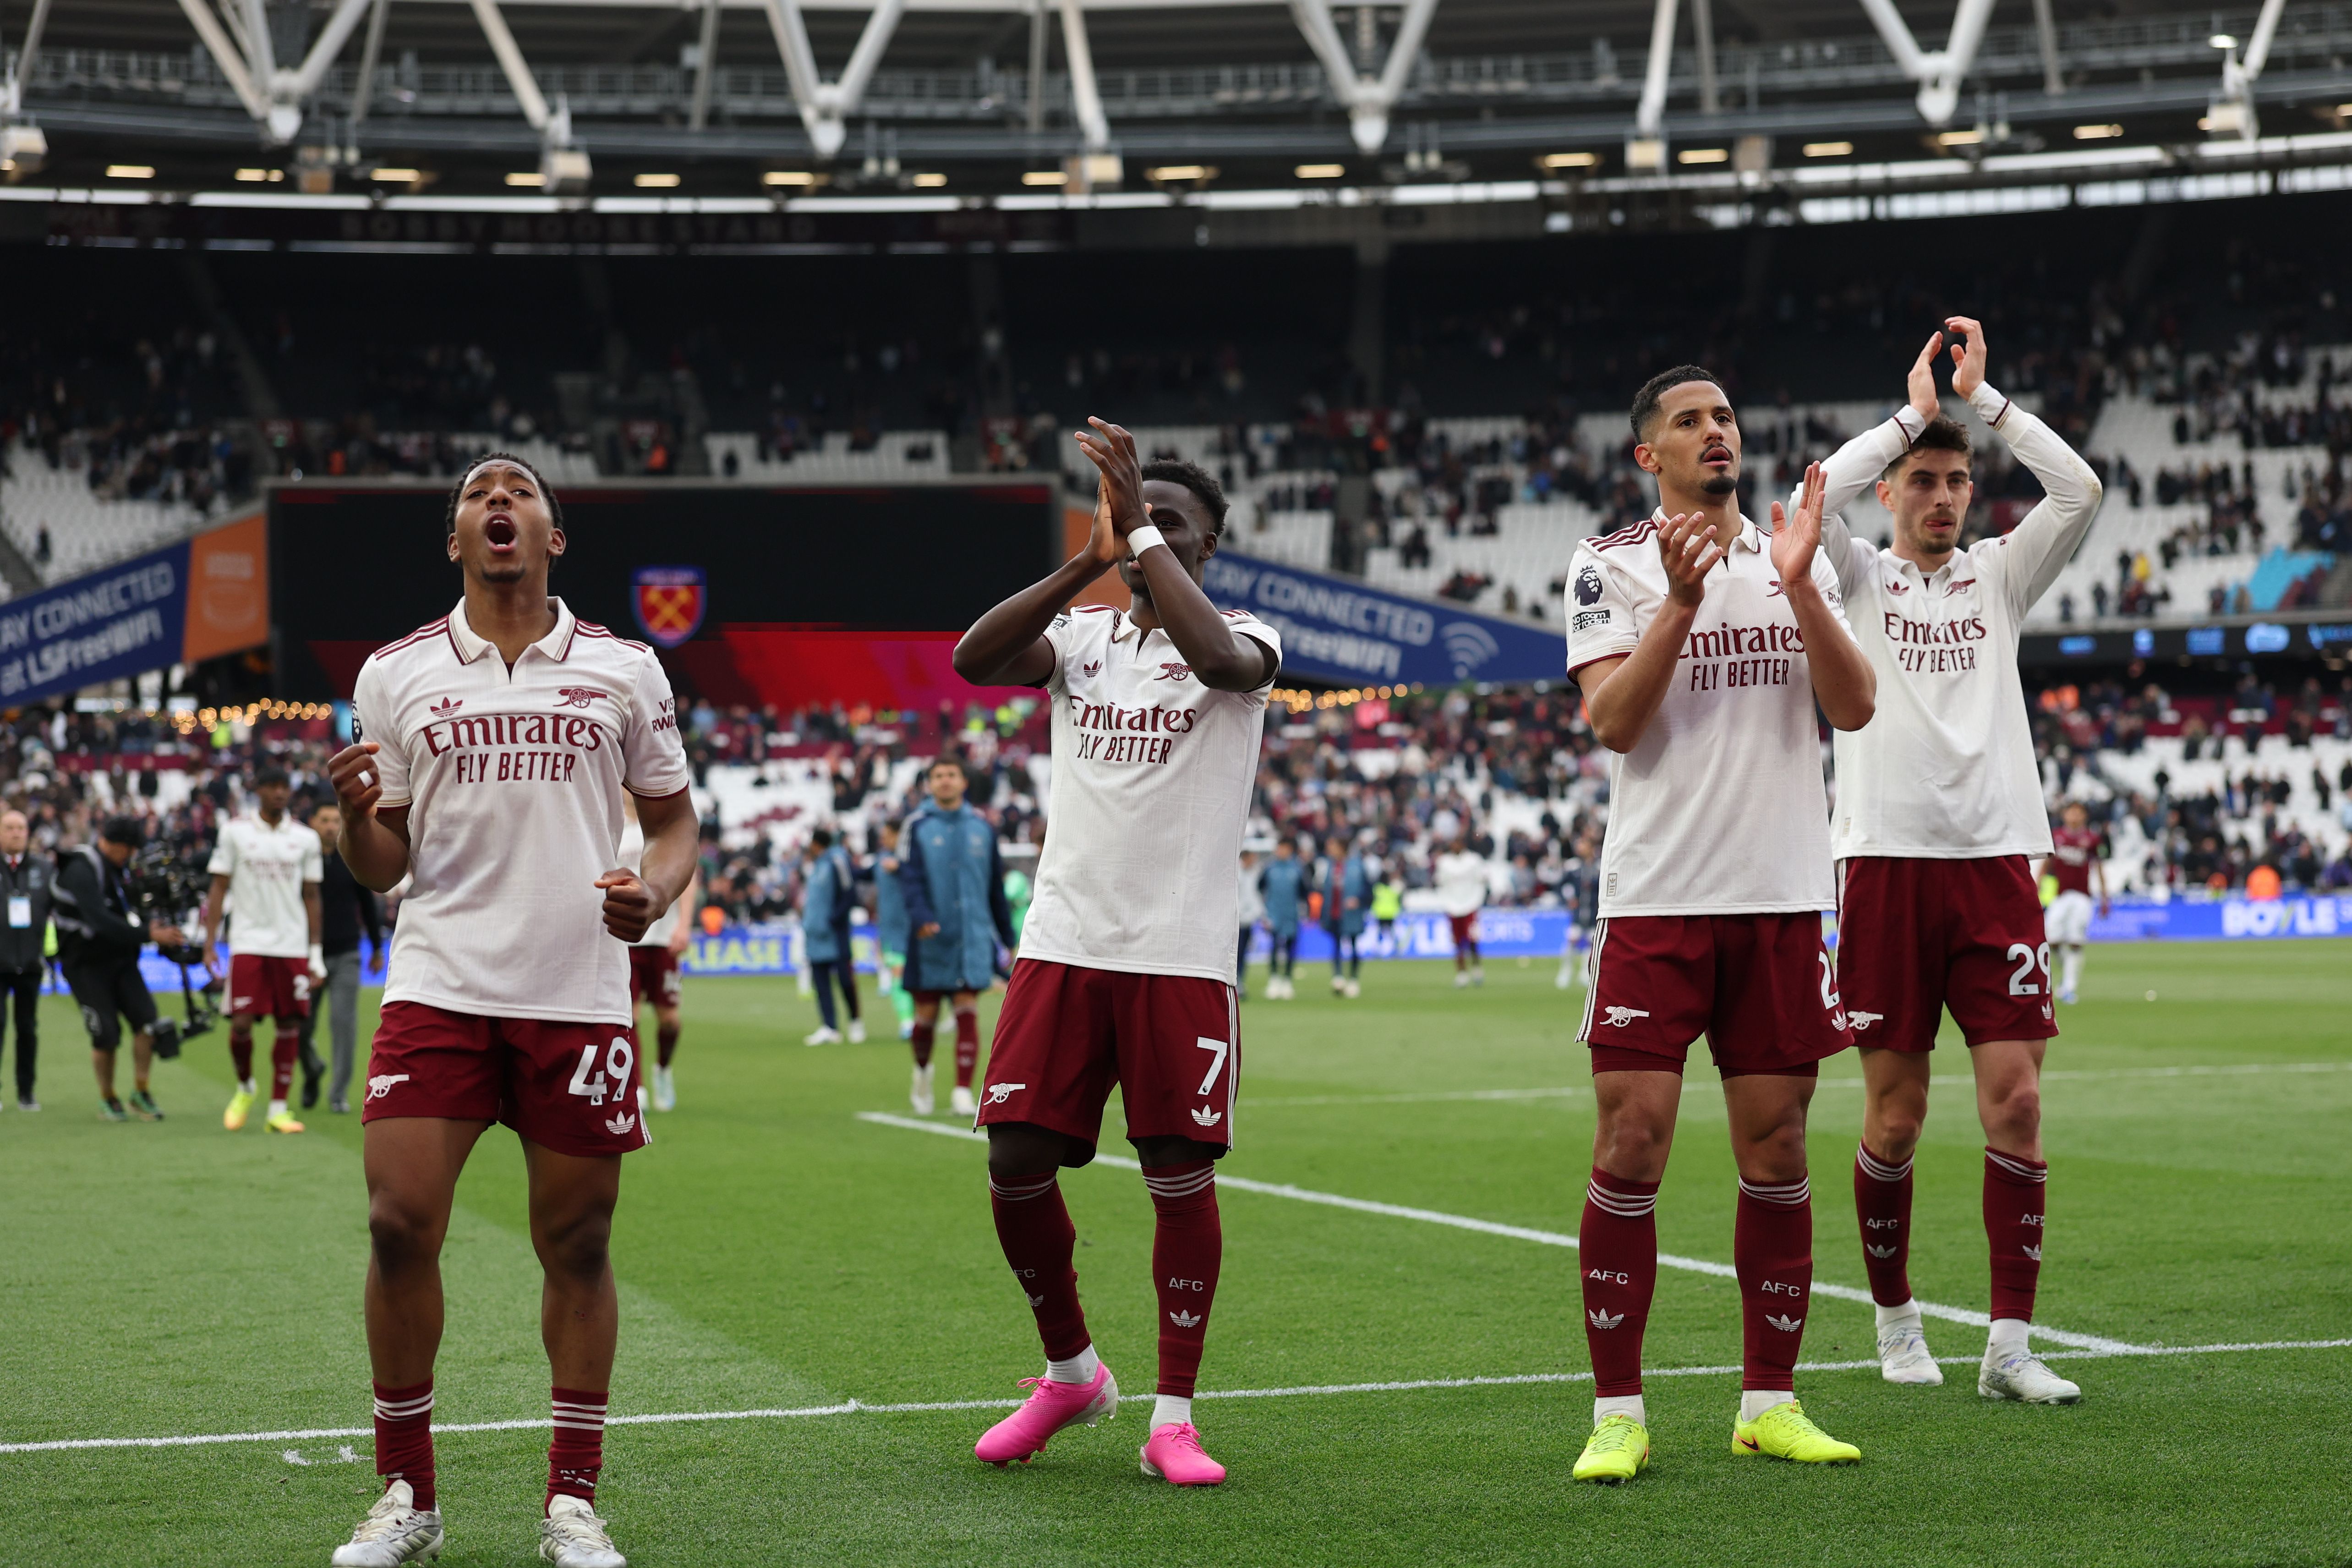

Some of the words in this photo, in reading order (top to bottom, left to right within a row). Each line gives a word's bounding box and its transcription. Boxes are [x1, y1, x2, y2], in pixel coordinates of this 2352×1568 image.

[32, 561, 176, 641] CONNECTED
[1256, 570, 1435, 647] CONNECTED
[1572, 616, 1581, 625] No
[1581, 612, 1606, 622] room
[1572, 623, 1581, 634] for
[1581, 617, 1611, 628] racism
[1678, 621, 1805, 659] mirates
[1690, 663, 1719, 692] FLY
[1728, 658, 1789, 688] BETTER
[1899, 648, 1926, 672] FLY
[421, 713, 603, 758] Emirates
[1077, 733, 1105, 759] FLY
[1103, 736, 1172, 765] BETTER
[457, 753, 490, 784] FLY
[498, 752, 576, 783] BETTER
[2007, 941, 2051, 996] 29
[568, 1036, 634, 1106] 49
[1197, 1036, 1228, 1096] 7
[1866, 1217, 1898, 1230] AFC
[2021, 1213, 2045, 1227] AFC
[1169, 1277, 1203, 1291] AFC
[1589, 1268, 1629, 1285] AFC
[1761, 1280, 1800, 1297] AFC
